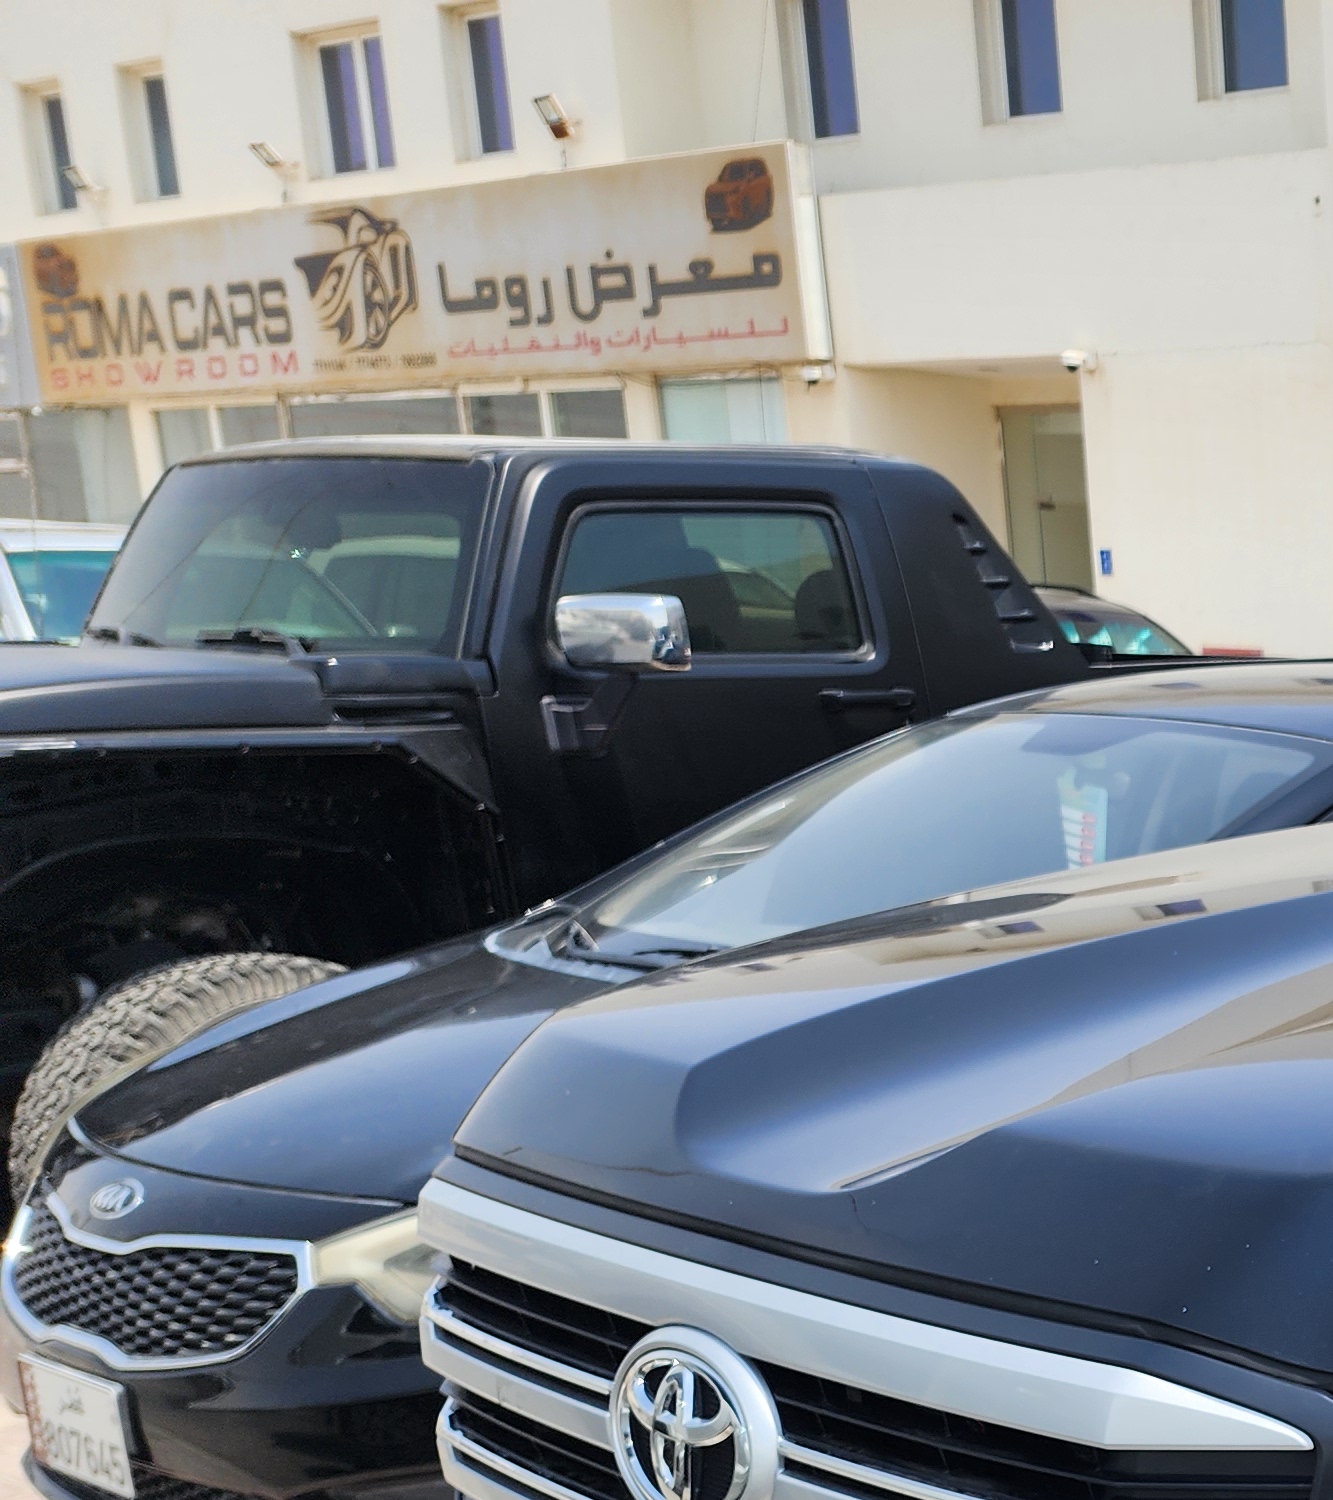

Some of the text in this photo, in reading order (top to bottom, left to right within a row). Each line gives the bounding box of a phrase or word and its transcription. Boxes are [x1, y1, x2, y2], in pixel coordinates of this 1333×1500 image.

[436, 249, 784, 327] معرض روما
[42, 292, 167, 364] ROMA
[168, 278, 294, 352] CARS
[606, 316, 790, 351] للسيارات
[51, 350, 300, 391] SHOWROOM
